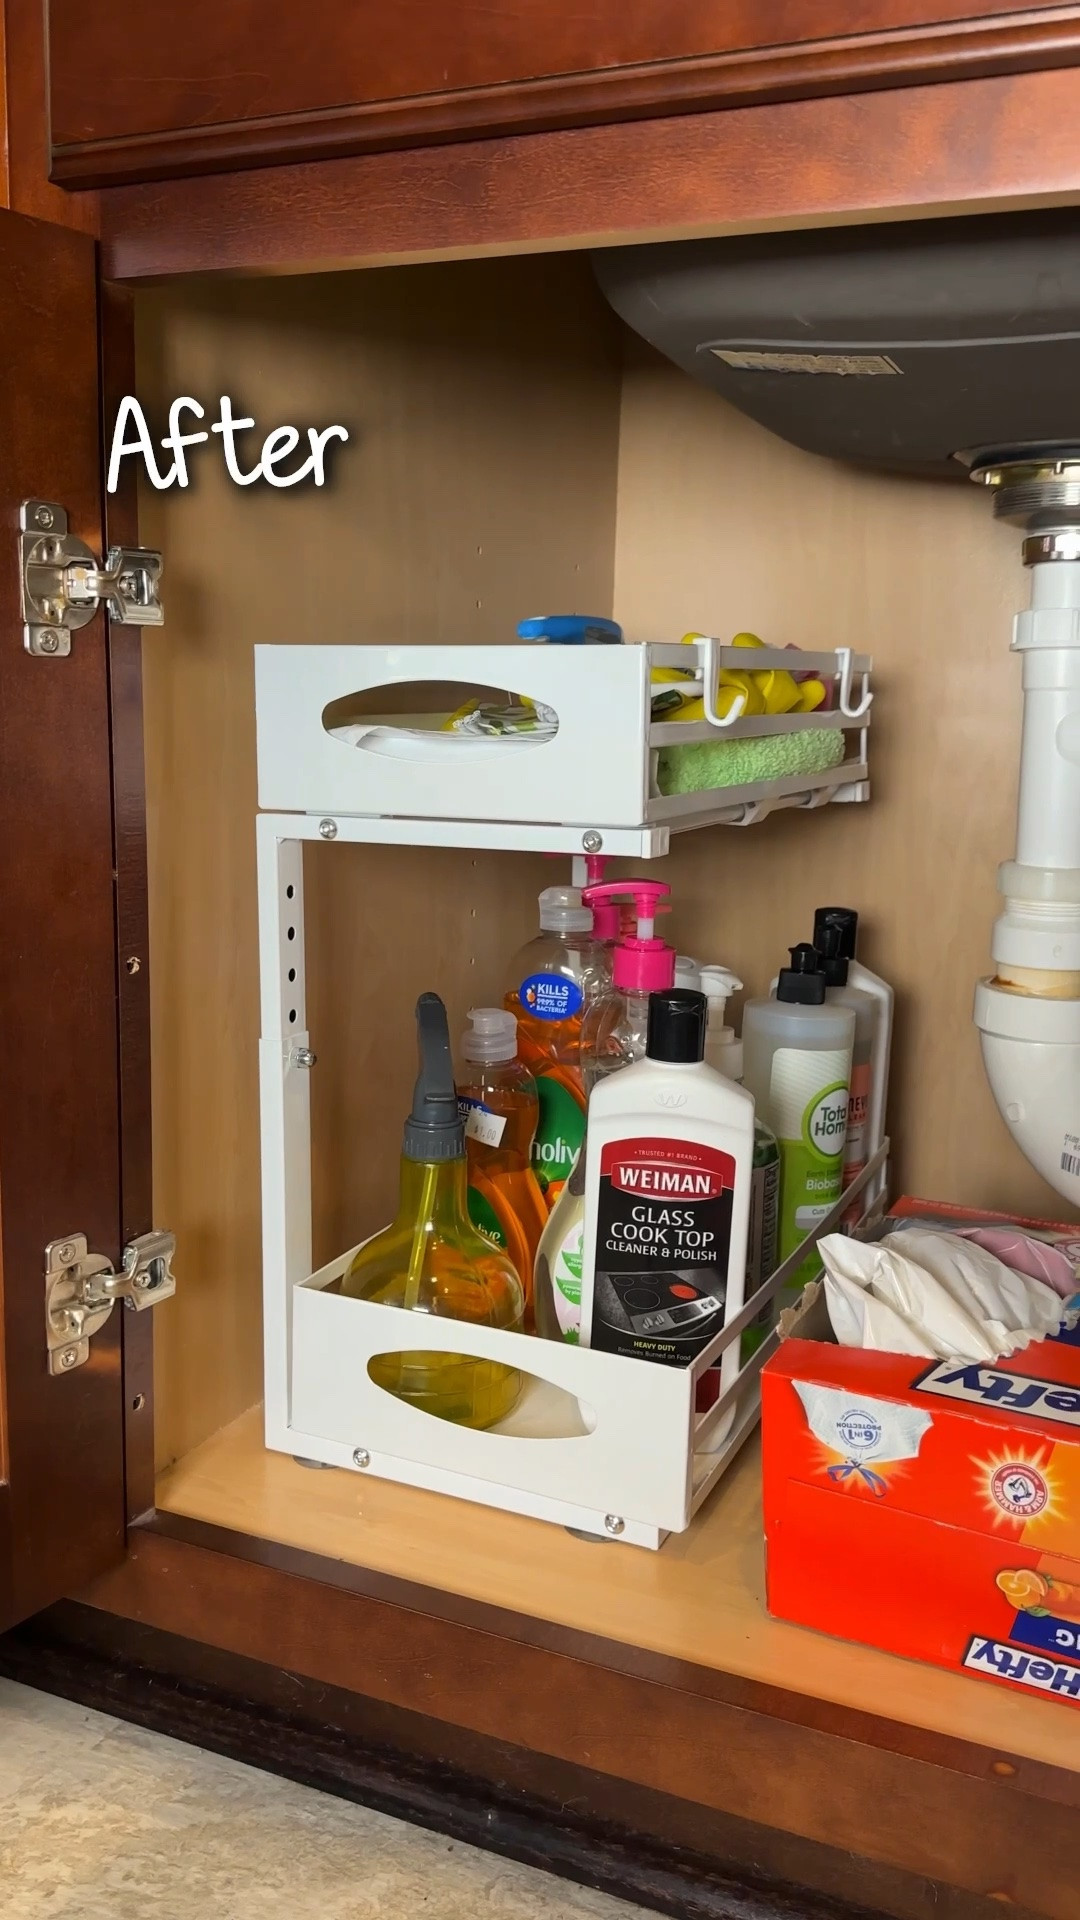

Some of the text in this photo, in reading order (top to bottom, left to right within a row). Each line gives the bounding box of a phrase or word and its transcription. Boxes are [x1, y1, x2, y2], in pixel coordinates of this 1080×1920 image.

[537, 983, 569, 997] KILLS
[556, 1000, 568, 1008] OF
[638, 1149, 665, 1157] TRUSTED
[676, 1153, 698, 1161] BRAND
[619, 1166, 711, 1194] WEIMAN
[631, 1206, 695, 1227] GLASS
[610, 1222, 715, 1248] COOK TOP
[605, 1239, 717, 1261] CLEANER & POLISH
[617, 1346, 644, 1356] Removes
[645, 1350, 667, 1359] Burned
[633, 1340, 676, 1352] HEAVY DUTY
[836, 1422, 882, 1431] PROTECTION
[848, 1429, 855, 1440] 1
[863, 1430, 875, 1441] 6
[994, 1480, 1024, 1514] HAMMER
[1031, 1489, 1045, 1510] ARM
[971, 1641, 1080, 1696] Hefty
